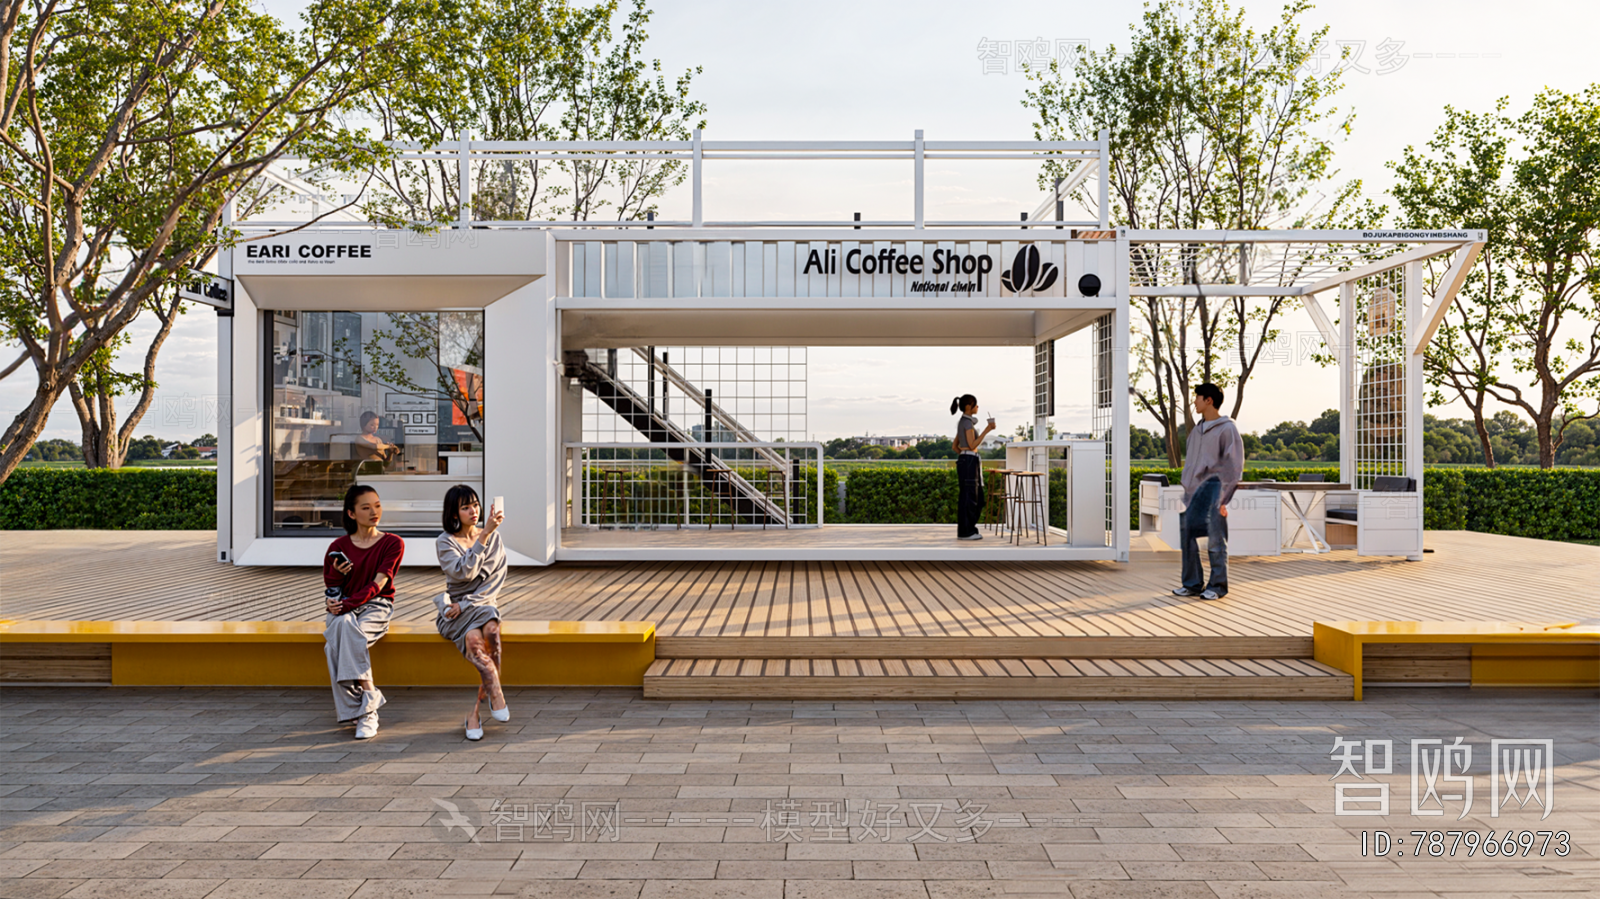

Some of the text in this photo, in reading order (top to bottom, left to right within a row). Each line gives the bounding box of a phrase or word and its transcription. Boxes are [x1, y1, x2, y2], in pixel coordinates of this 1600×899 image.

[246, 244, 372, 259] EARI COFFEE
[803, 248, 993, 293] Ali Coffee Shop
